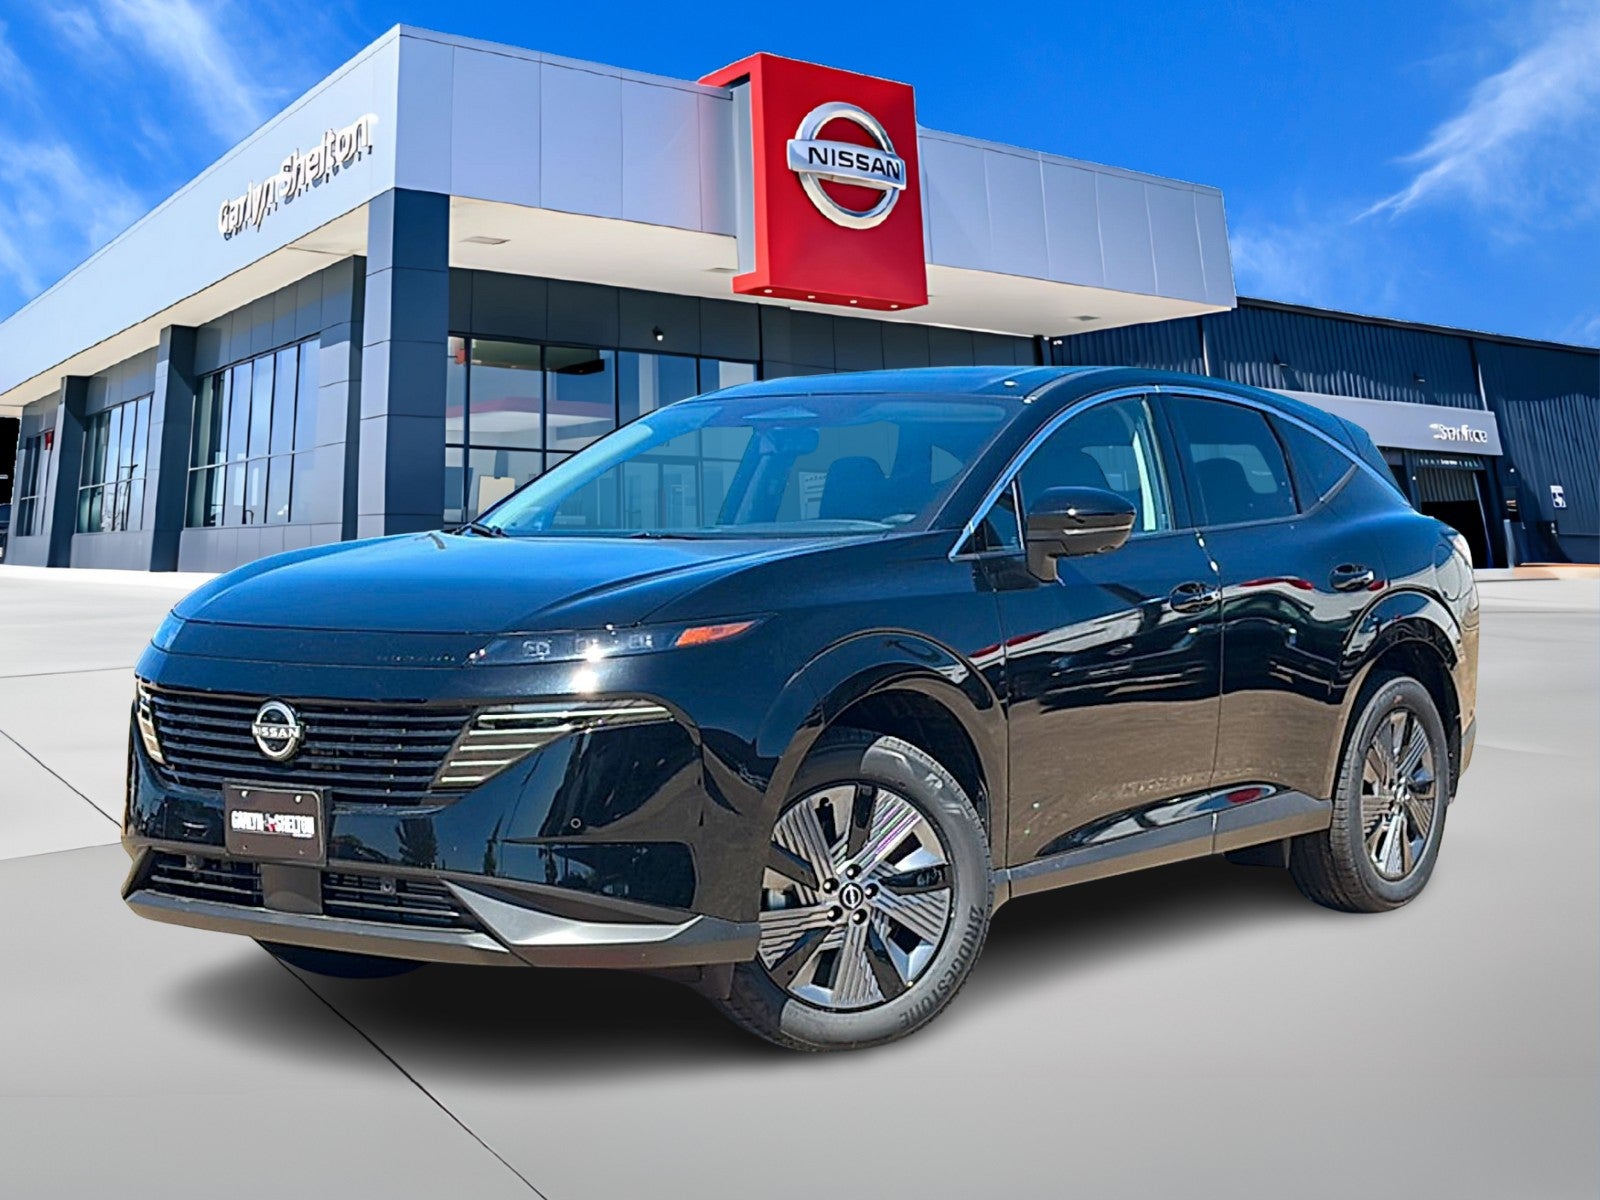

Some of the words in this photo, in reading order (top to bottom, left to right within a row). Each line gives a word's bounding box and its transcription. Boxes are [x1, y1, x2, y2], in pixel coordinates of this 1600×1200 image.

[808, 147, 900, 180] NISSAN
[253, 726, 300, 738] NISSAN
[899, 904, 984, 1028] BRIDGESTONE
